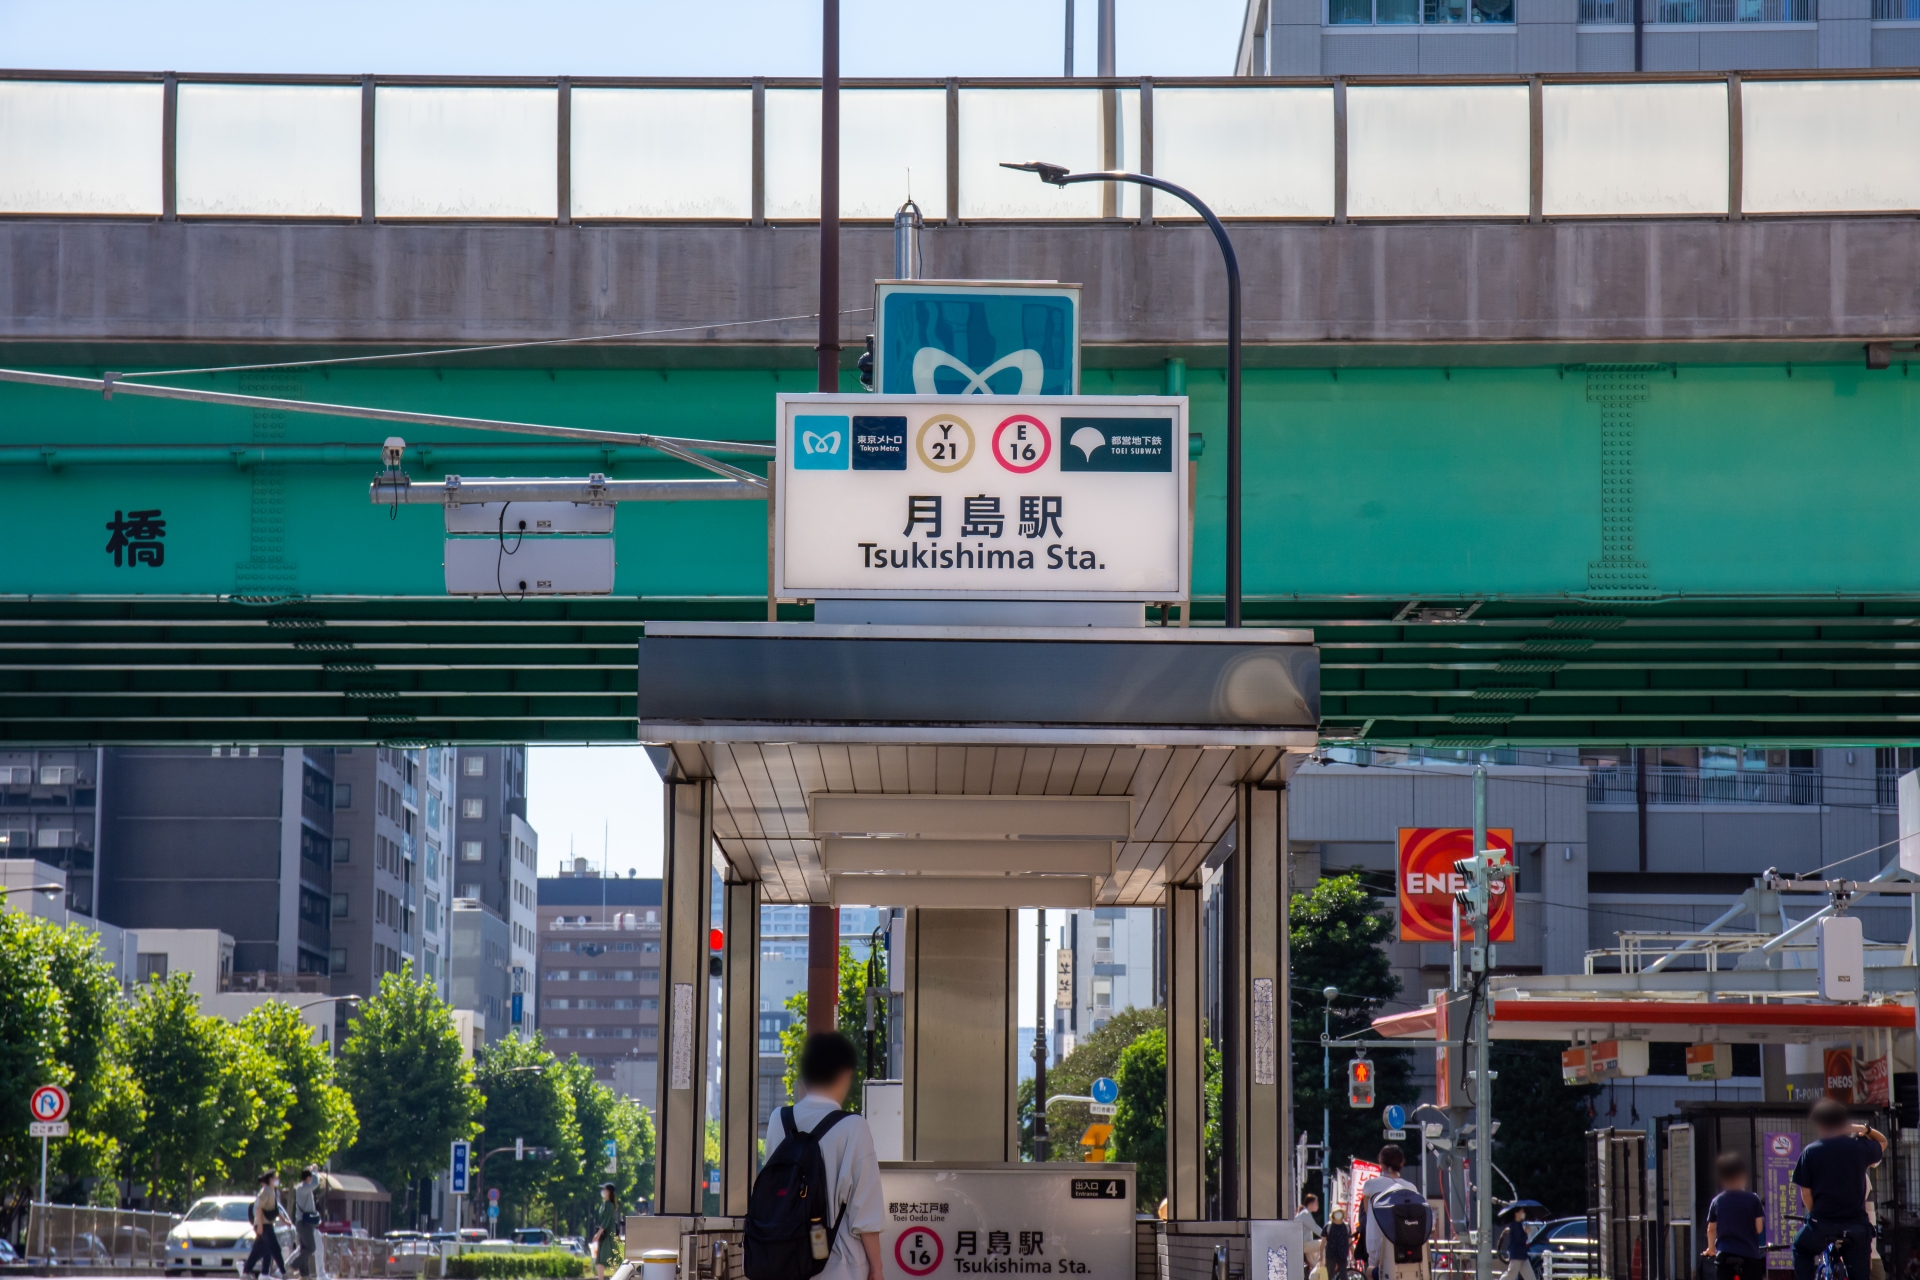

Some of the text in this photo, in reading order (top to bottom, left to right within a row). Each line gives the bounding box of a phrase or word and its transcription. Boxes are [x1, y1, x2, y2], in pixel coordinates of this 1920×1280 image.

[857, 435, 903, 445] 東京メトロ
[939, 425, 953, 440] Y
[1017, 425, 1027, 440] E
[1111, 436, 1162, 446] 都営地下鉄
[932, 443, 956, 459] 21
[1010, 443, 1036, 460] 16
[1130, 447, 1162, 455] SUBWAY
[903, 494, 1063, 538] 月島駅
[105, 509, 167, 568] 橋
[858, 542, 1106, 570] Tsukishima Sta.
[1407, 873, 1505, 895] ENES
[1828, 1076, 1853, 1089] ENEOS
[1795, 1088, 1824, 1101] T-POINT
[31, 1125, 62, 1134] ここまで
[455, 1148, 465, 1188] 初見橋
[1075, 1182, 1099, 1190] 出入口
[1106, 1181, 1117, 1197] 4
[889, 1202, 950, 1214] 都営大江戸線
[915, 1235, 923, 1248] E
[955, 1230, 1044, 1256] 月島駅
[910, 1251, 931, 1265] 16
[954, 1258, 1092, 1274] Tsukishima Sta.
